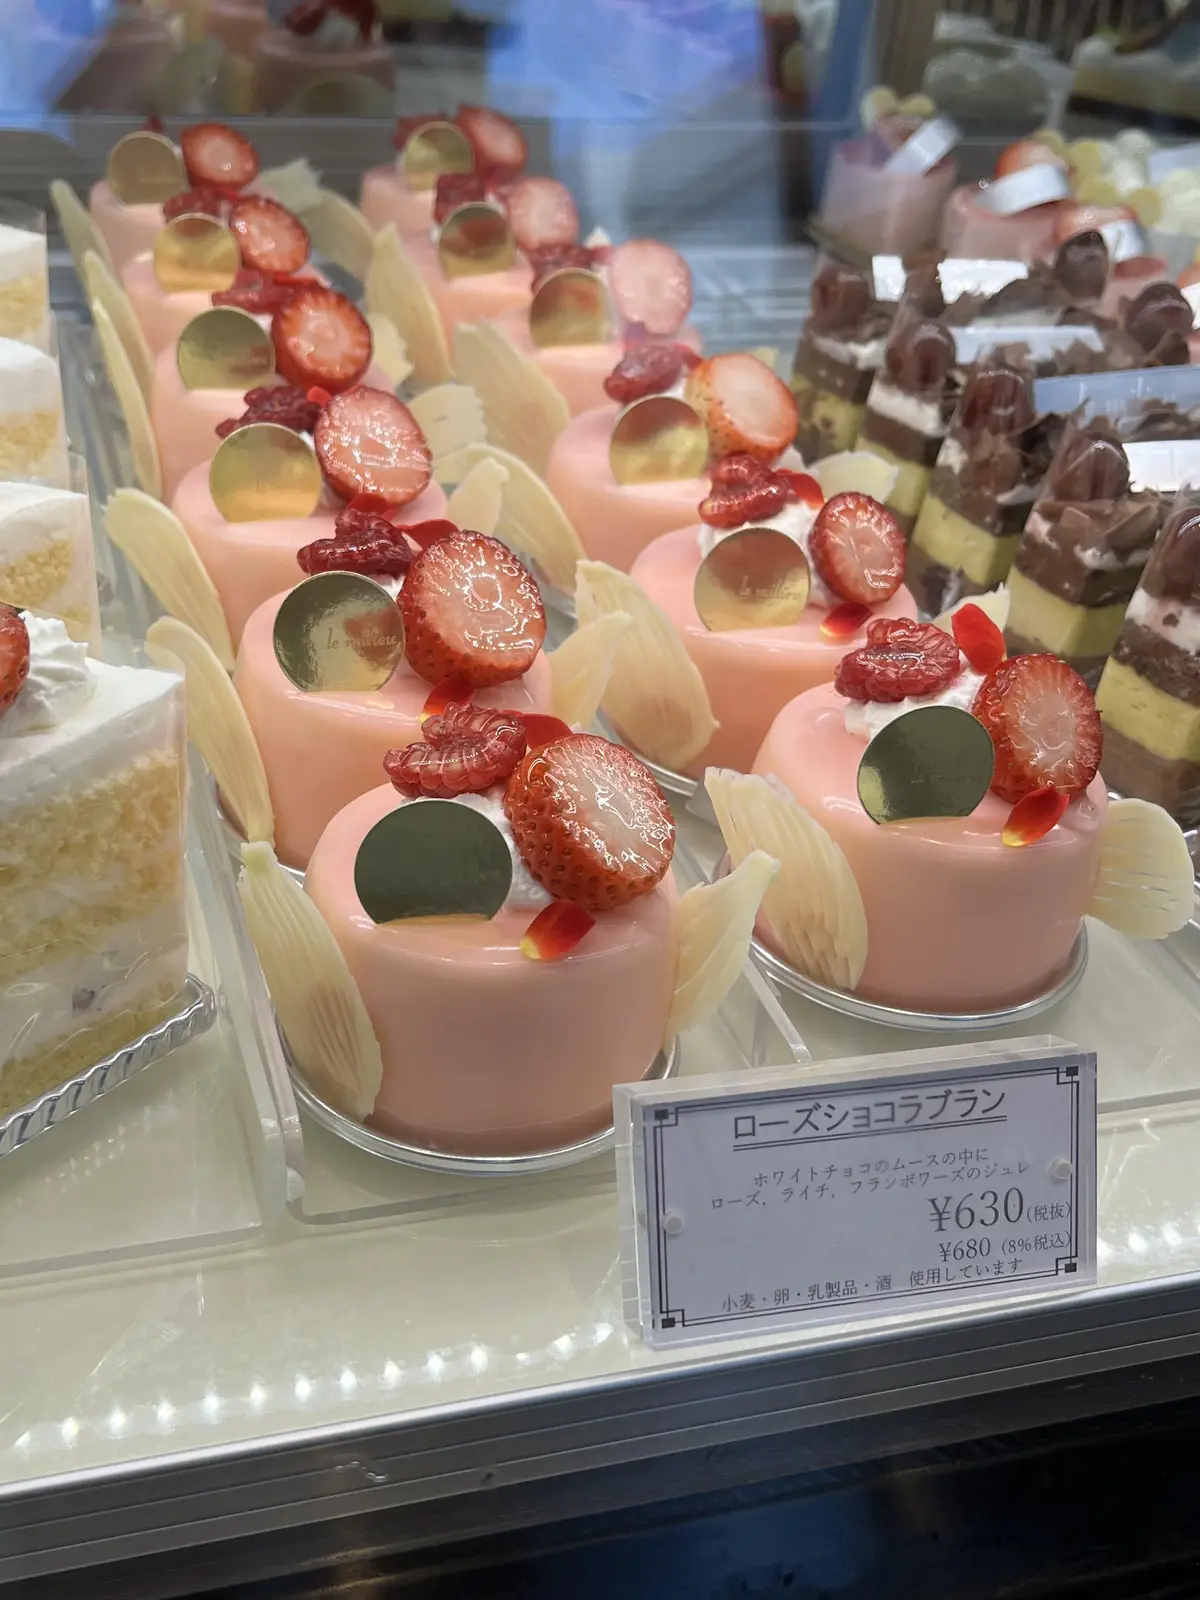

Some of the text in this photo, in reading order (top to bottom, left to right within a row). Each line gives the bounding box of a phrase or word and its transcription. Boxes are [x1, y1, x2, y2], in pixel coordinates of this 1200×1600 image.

[733, 1089, 1006, 1140] ローズショコラブラン
[753, 1147, 990, 1187] ホワイトチョコのムースの中に
[938, 1236, 992, 1263] ¥680
[721, 1257, 1024, 1313] 小麦・卵・乳製品・酒 使用しています
